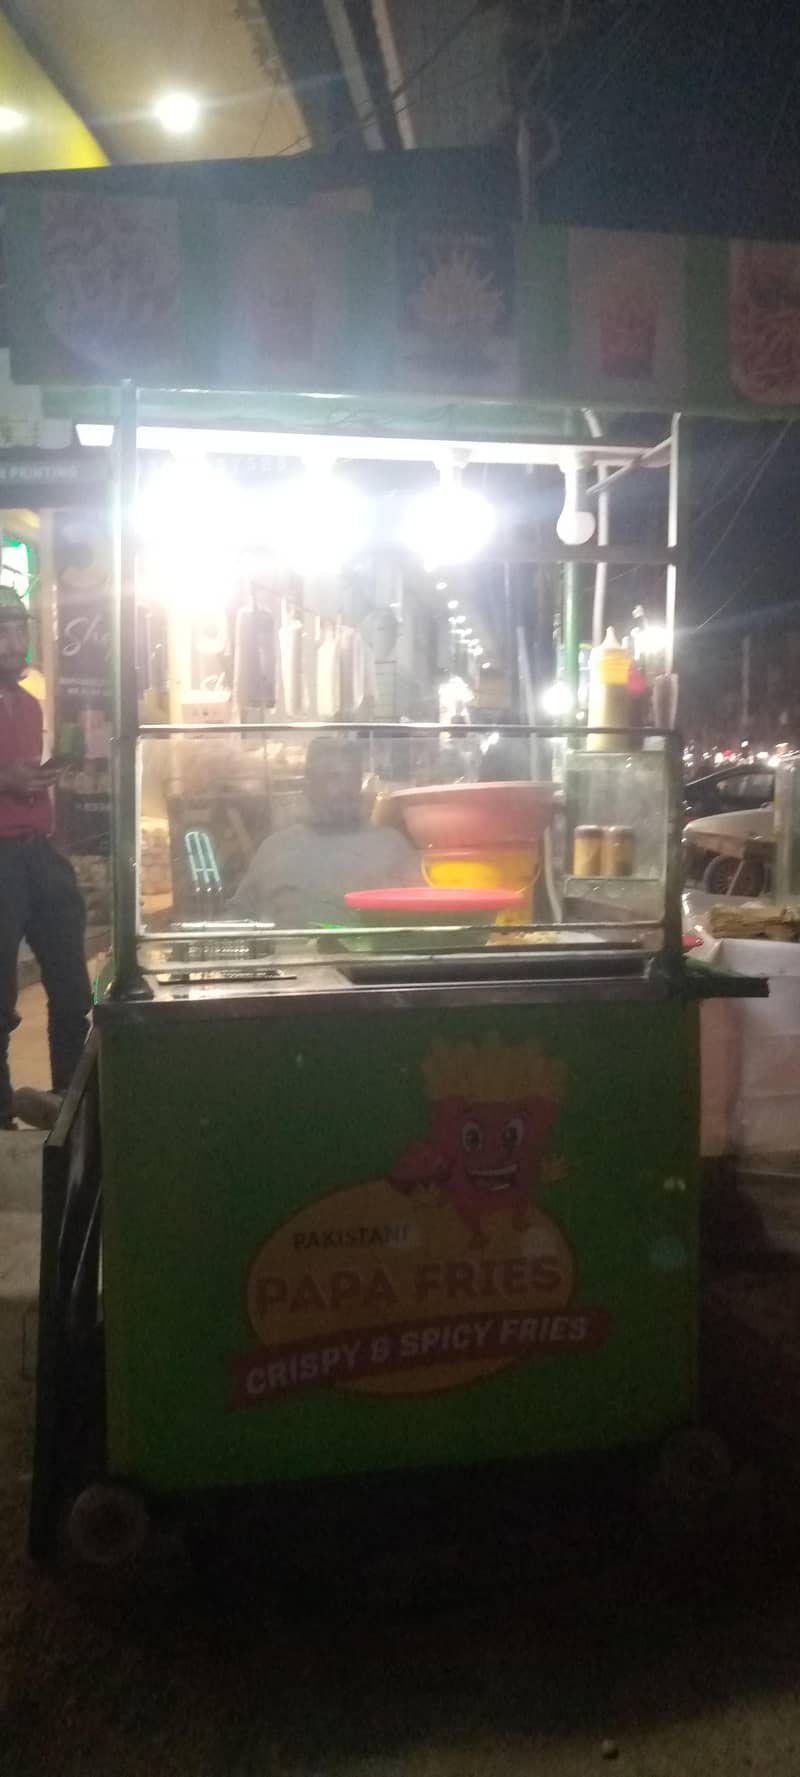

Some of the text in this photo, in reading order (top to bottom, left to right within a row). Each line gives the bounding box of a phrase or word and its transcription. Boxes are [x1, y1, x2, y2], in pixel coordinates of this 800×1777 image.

[294, 1226, 408, 1249] PAKISTANI
[255, 1257, 561, 1313] PAPA FRIES
[246, 1342, 359, 1394] CRISPY
[400, 1320, 494, 1357] SPICY
[499, 1316, 588, 1344] FRIES
